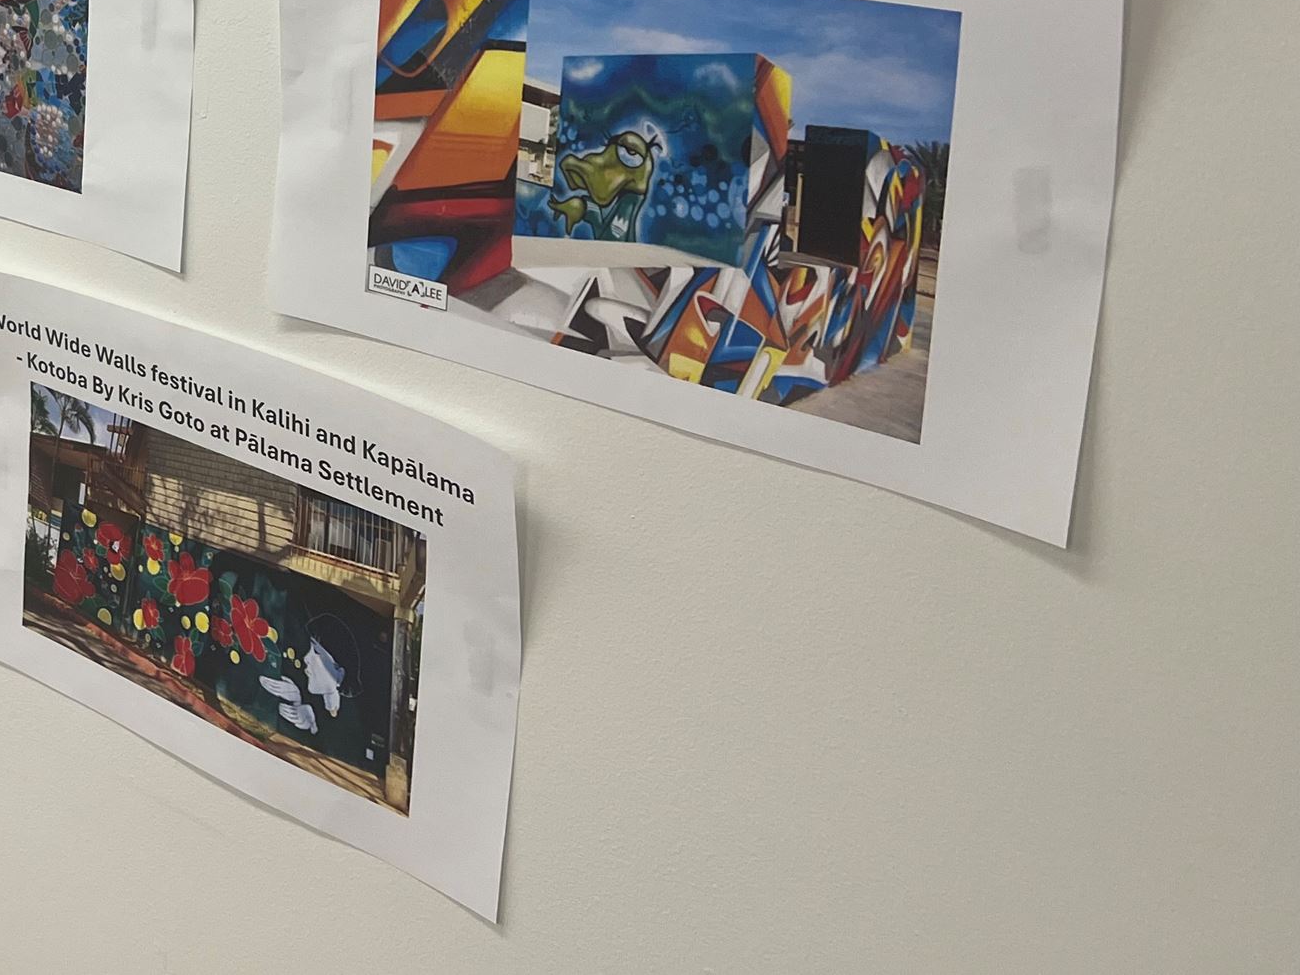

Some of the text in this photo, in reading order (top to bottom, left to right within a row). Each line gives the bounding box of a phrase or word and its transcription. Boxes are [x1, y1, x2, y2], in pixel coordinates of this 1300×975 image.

[373, 273, 407, 291] DAVID
[425, 286, 443, 301] LEE
[26, 352, 89, 391] Kotoba
[91, 374, 115, 402] By
[117, 384, 155, 415] Kris
[158, 400, 206, 434] Goto
[209, 423, 231, 444] at
[234, 426, 314, 475] Pālama
[317, 458, 445, 528] Settlement
[44, 326, 92, 359] Wide
[94, 343, 147, 379] Walls
[150, 364, 224, 408] festival
[228, 389, 247, 415] in
[251, 398, 310, 438] Kalihi
[315, 427, 357, 456] and
[360, 438, 476, 506] Kapālama
